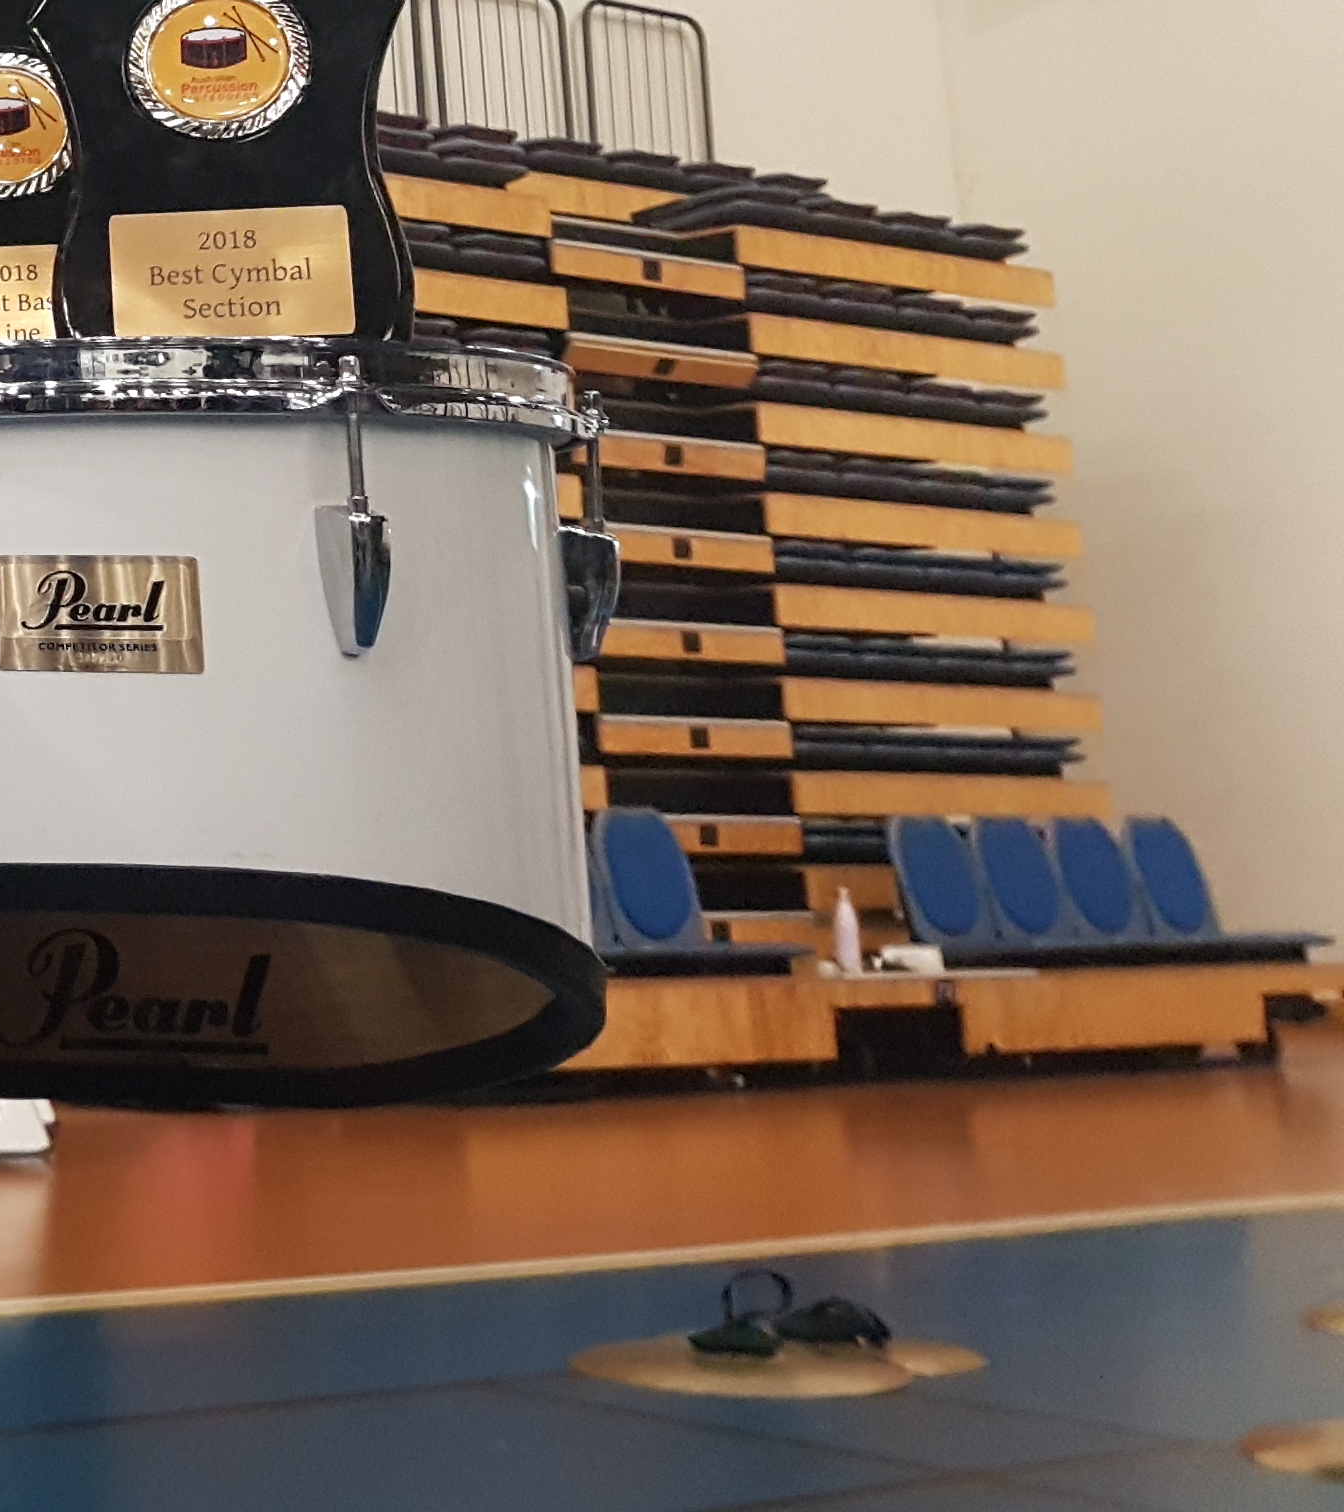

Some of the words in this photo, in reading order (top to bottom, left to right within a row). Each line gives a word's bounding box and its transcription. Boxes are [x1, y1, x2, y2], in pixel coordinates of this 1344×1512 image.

[181, 81, 258, 94] Percussion
[198, 230, 257, 251] 2018
[149, 265, 204, 286] Best
[212, 258, 313, 290] Cymbal
[182, 296, 282, 319] Section
[21, 570, 165, 630] Pearl
[118, 643, 158, 652] SERIES
